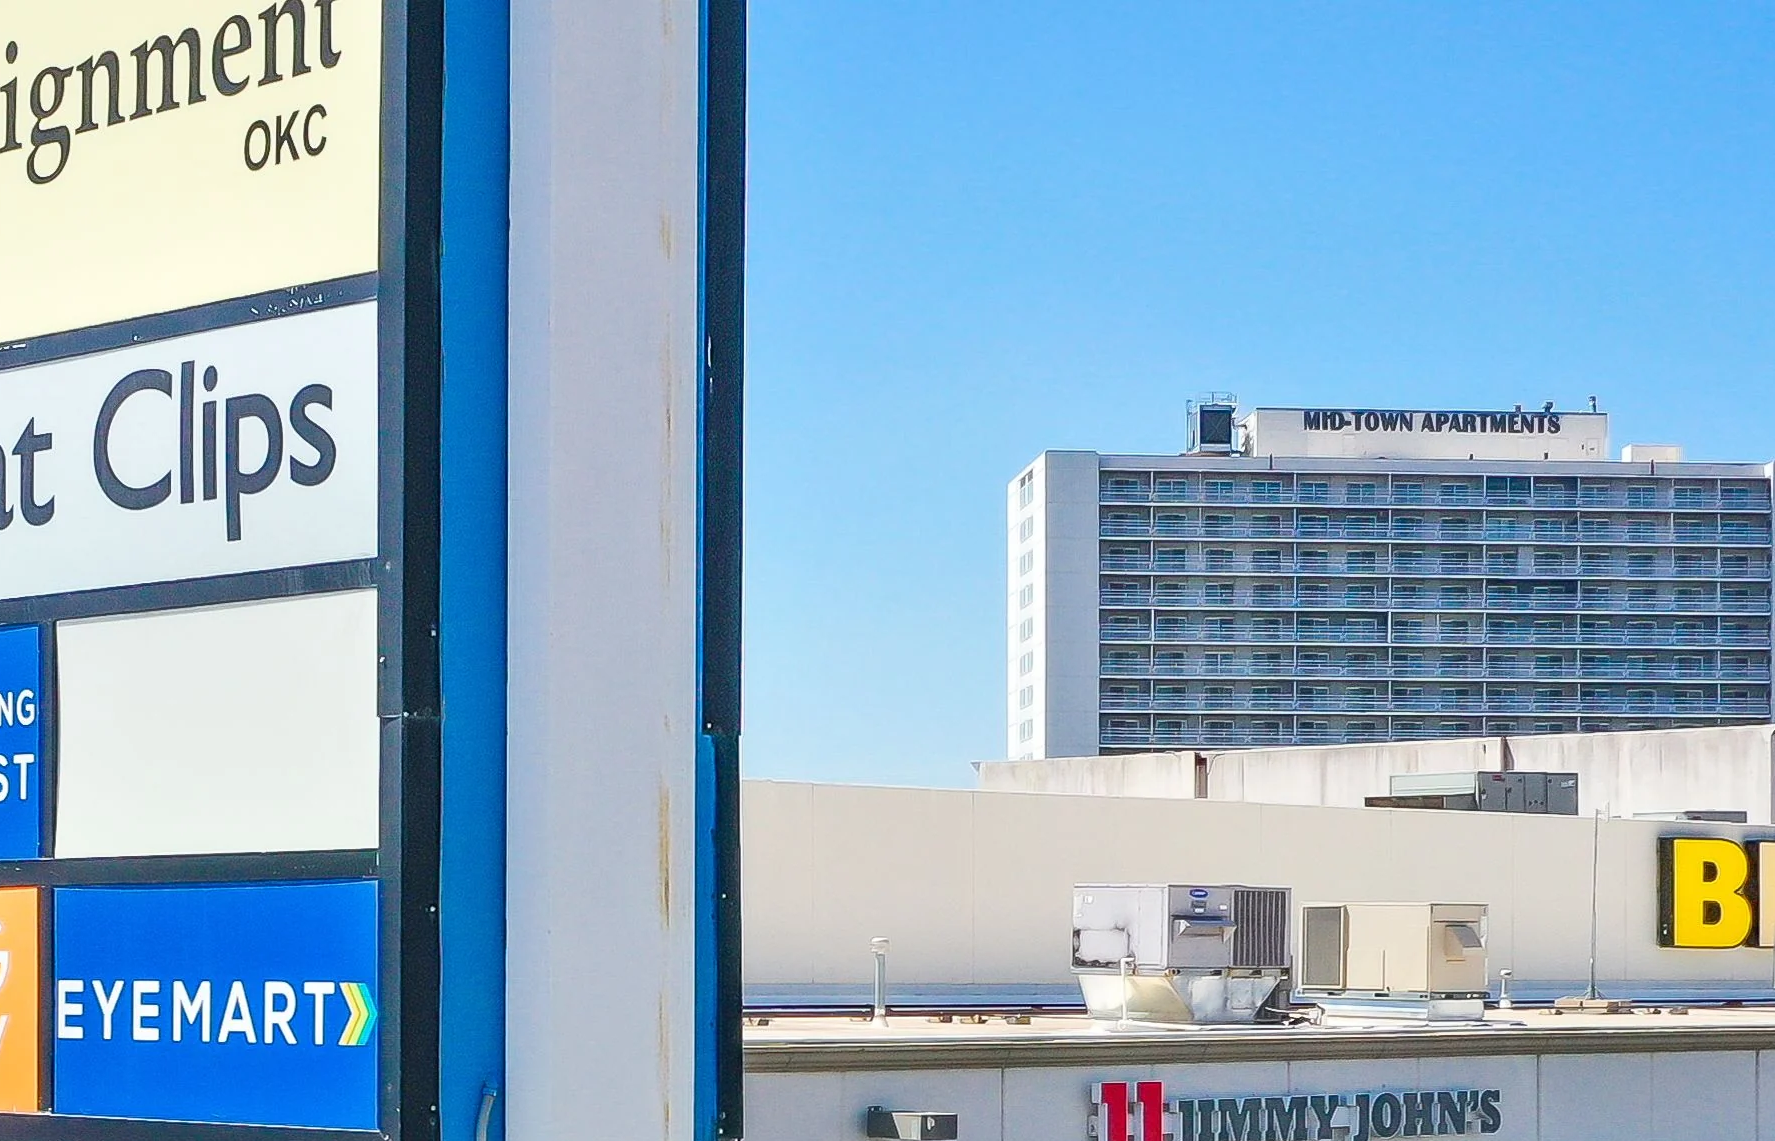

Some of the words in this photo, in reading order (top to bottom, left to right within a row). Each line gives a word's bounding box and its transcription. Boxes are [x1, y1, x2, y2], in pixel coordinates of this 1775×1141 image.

[243, 104, 328, 171] OKC
[93, 360, 337, 542] Clips
[1303, 411, 1413, 432] MID-TOWN
[1421, 412, 1561, 434] APARTMENTS
[57, 980, 335, 1045] EYEMART
